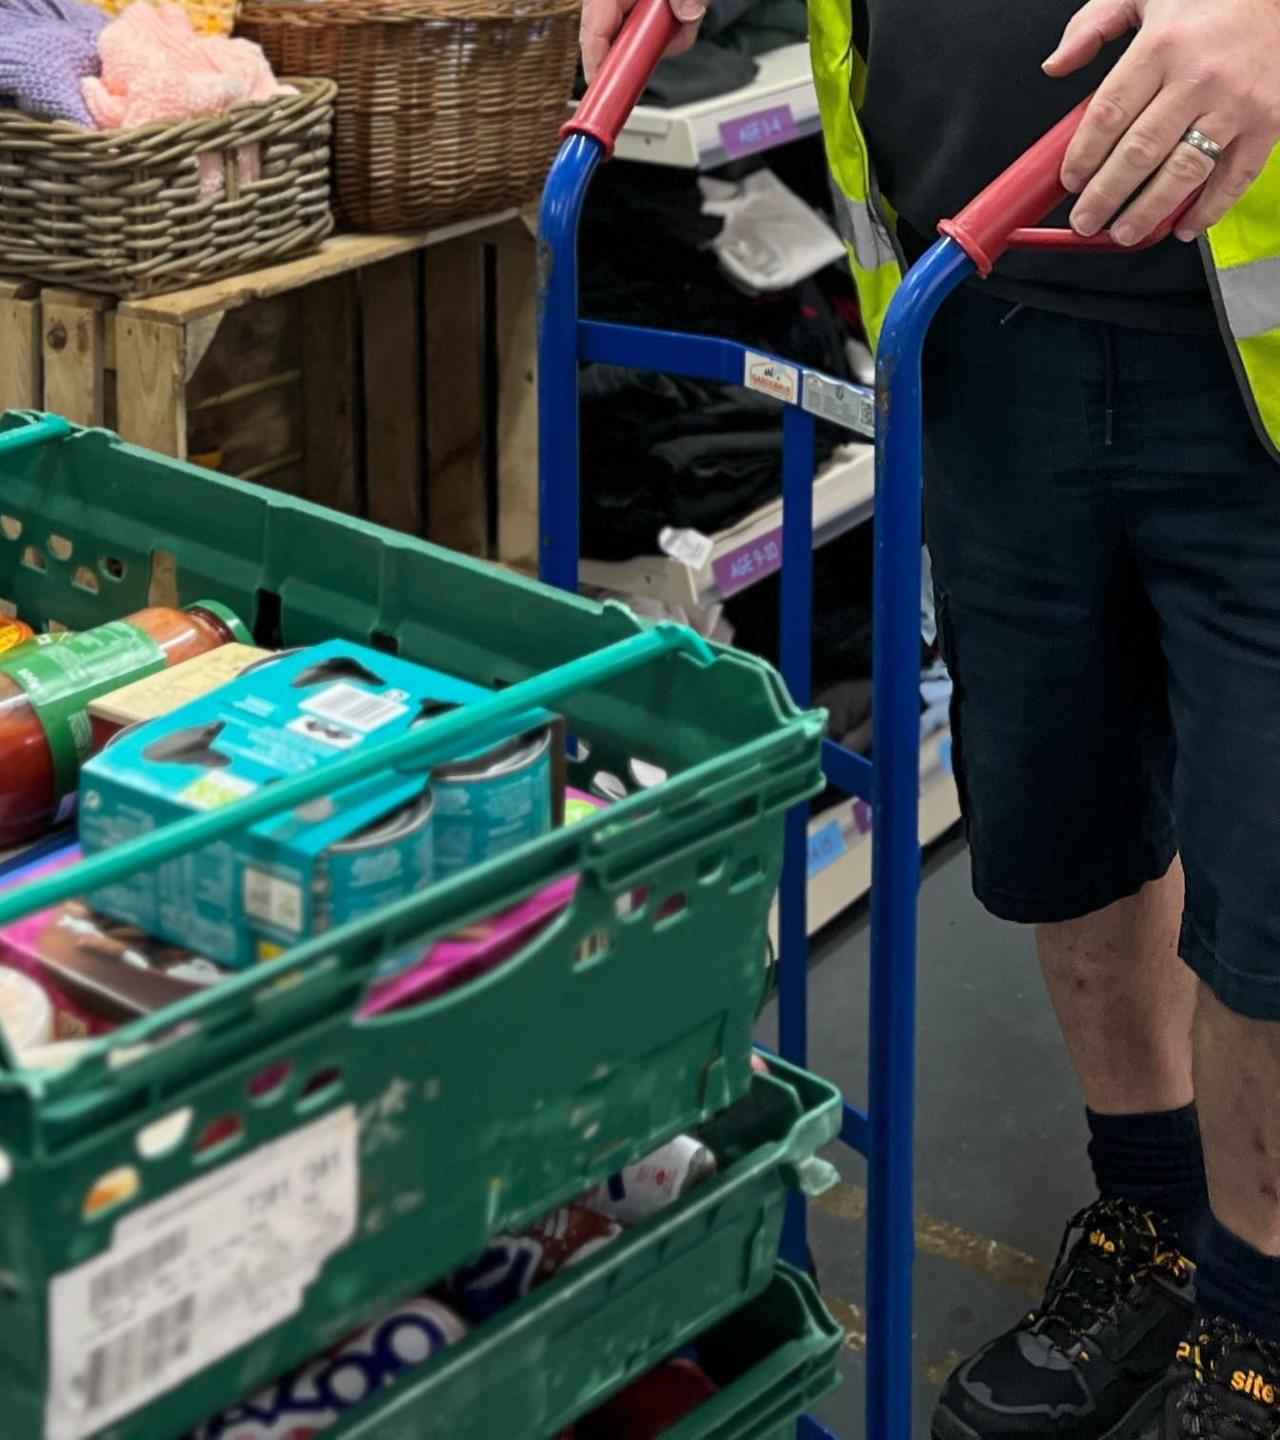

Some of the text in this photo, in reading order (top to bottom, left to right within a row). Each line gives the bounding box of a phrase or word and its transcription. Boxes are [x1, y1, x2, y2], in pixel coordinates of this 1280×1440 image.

[730, 541, 779, 579] AGE 9-10
[1231, 1369, 1274, 1404] site
